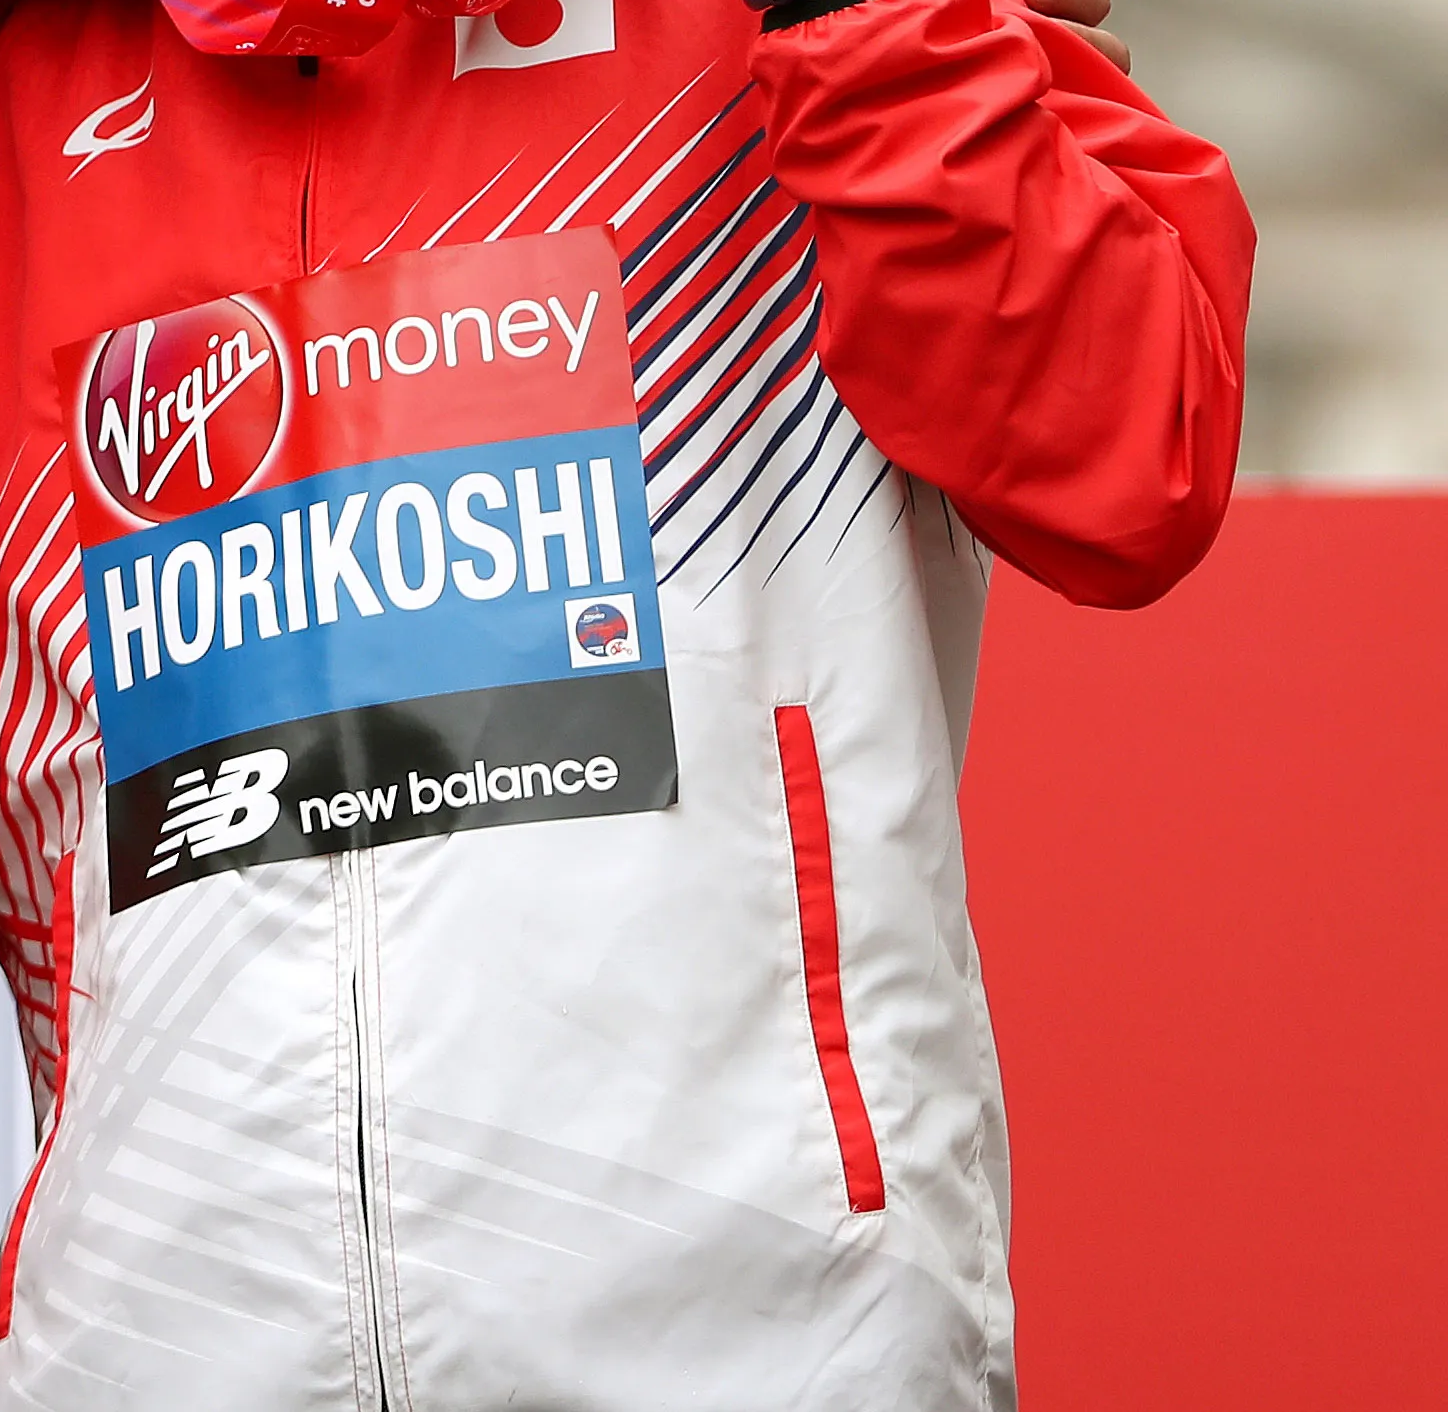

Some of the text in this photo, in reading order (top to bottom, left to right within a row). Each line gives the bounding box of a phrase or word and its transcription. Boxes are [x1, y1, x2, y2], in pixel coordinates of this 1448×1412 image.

[97, 290, 600, 503] Virgin money
[102, 456, 625, 693] HORIKOSHI
[298, 784, 398, 836] new
[408, 751, 619, 816] balance
